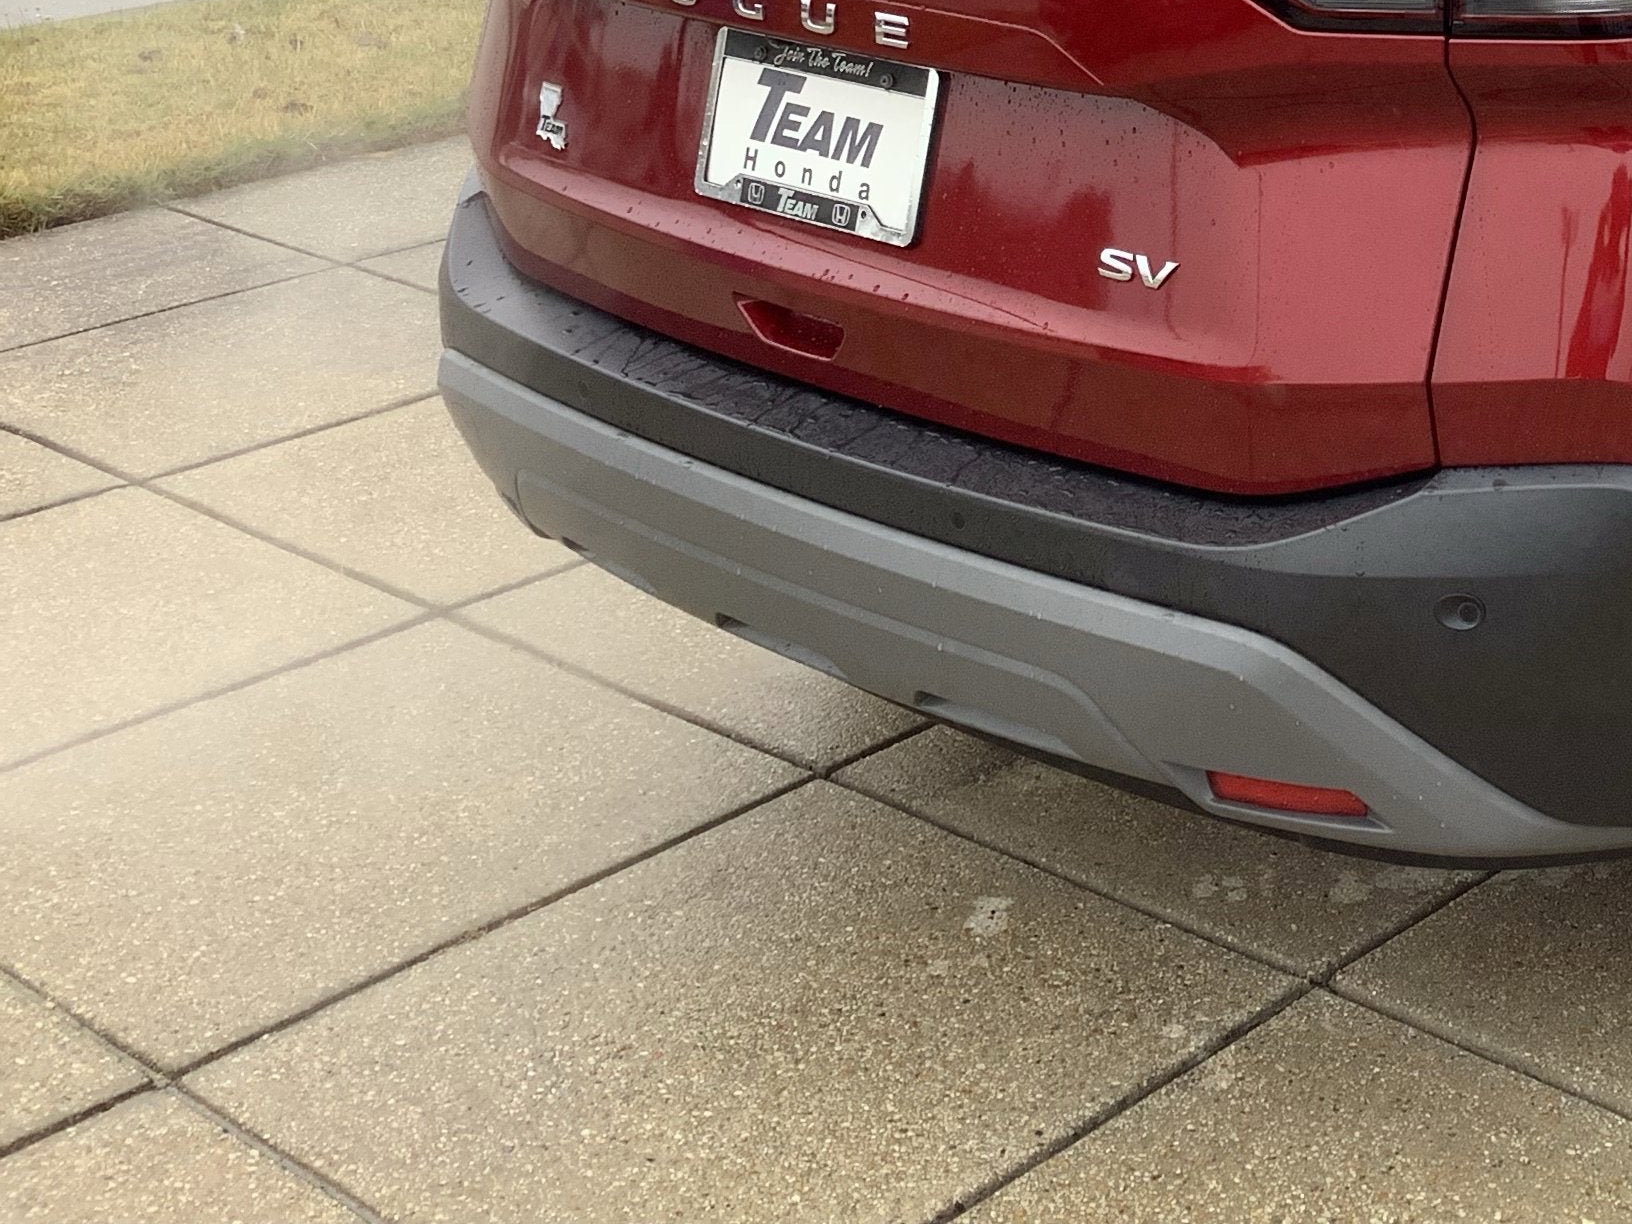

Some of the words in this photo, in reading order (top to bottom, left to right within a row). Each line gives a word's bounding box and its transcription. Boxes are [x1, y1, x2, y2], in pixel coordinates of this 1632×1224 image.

[771, 43, 806, 66] Join
[807, 47, 831, 68] The
[831, 52, 875, 78] Team!
[750, 68, 884, 169] TEAM
[743, 147, 871, 202] Honda
[776, 187, 820, 221] TEAM
[1097, 248, 1180, 290] SV
